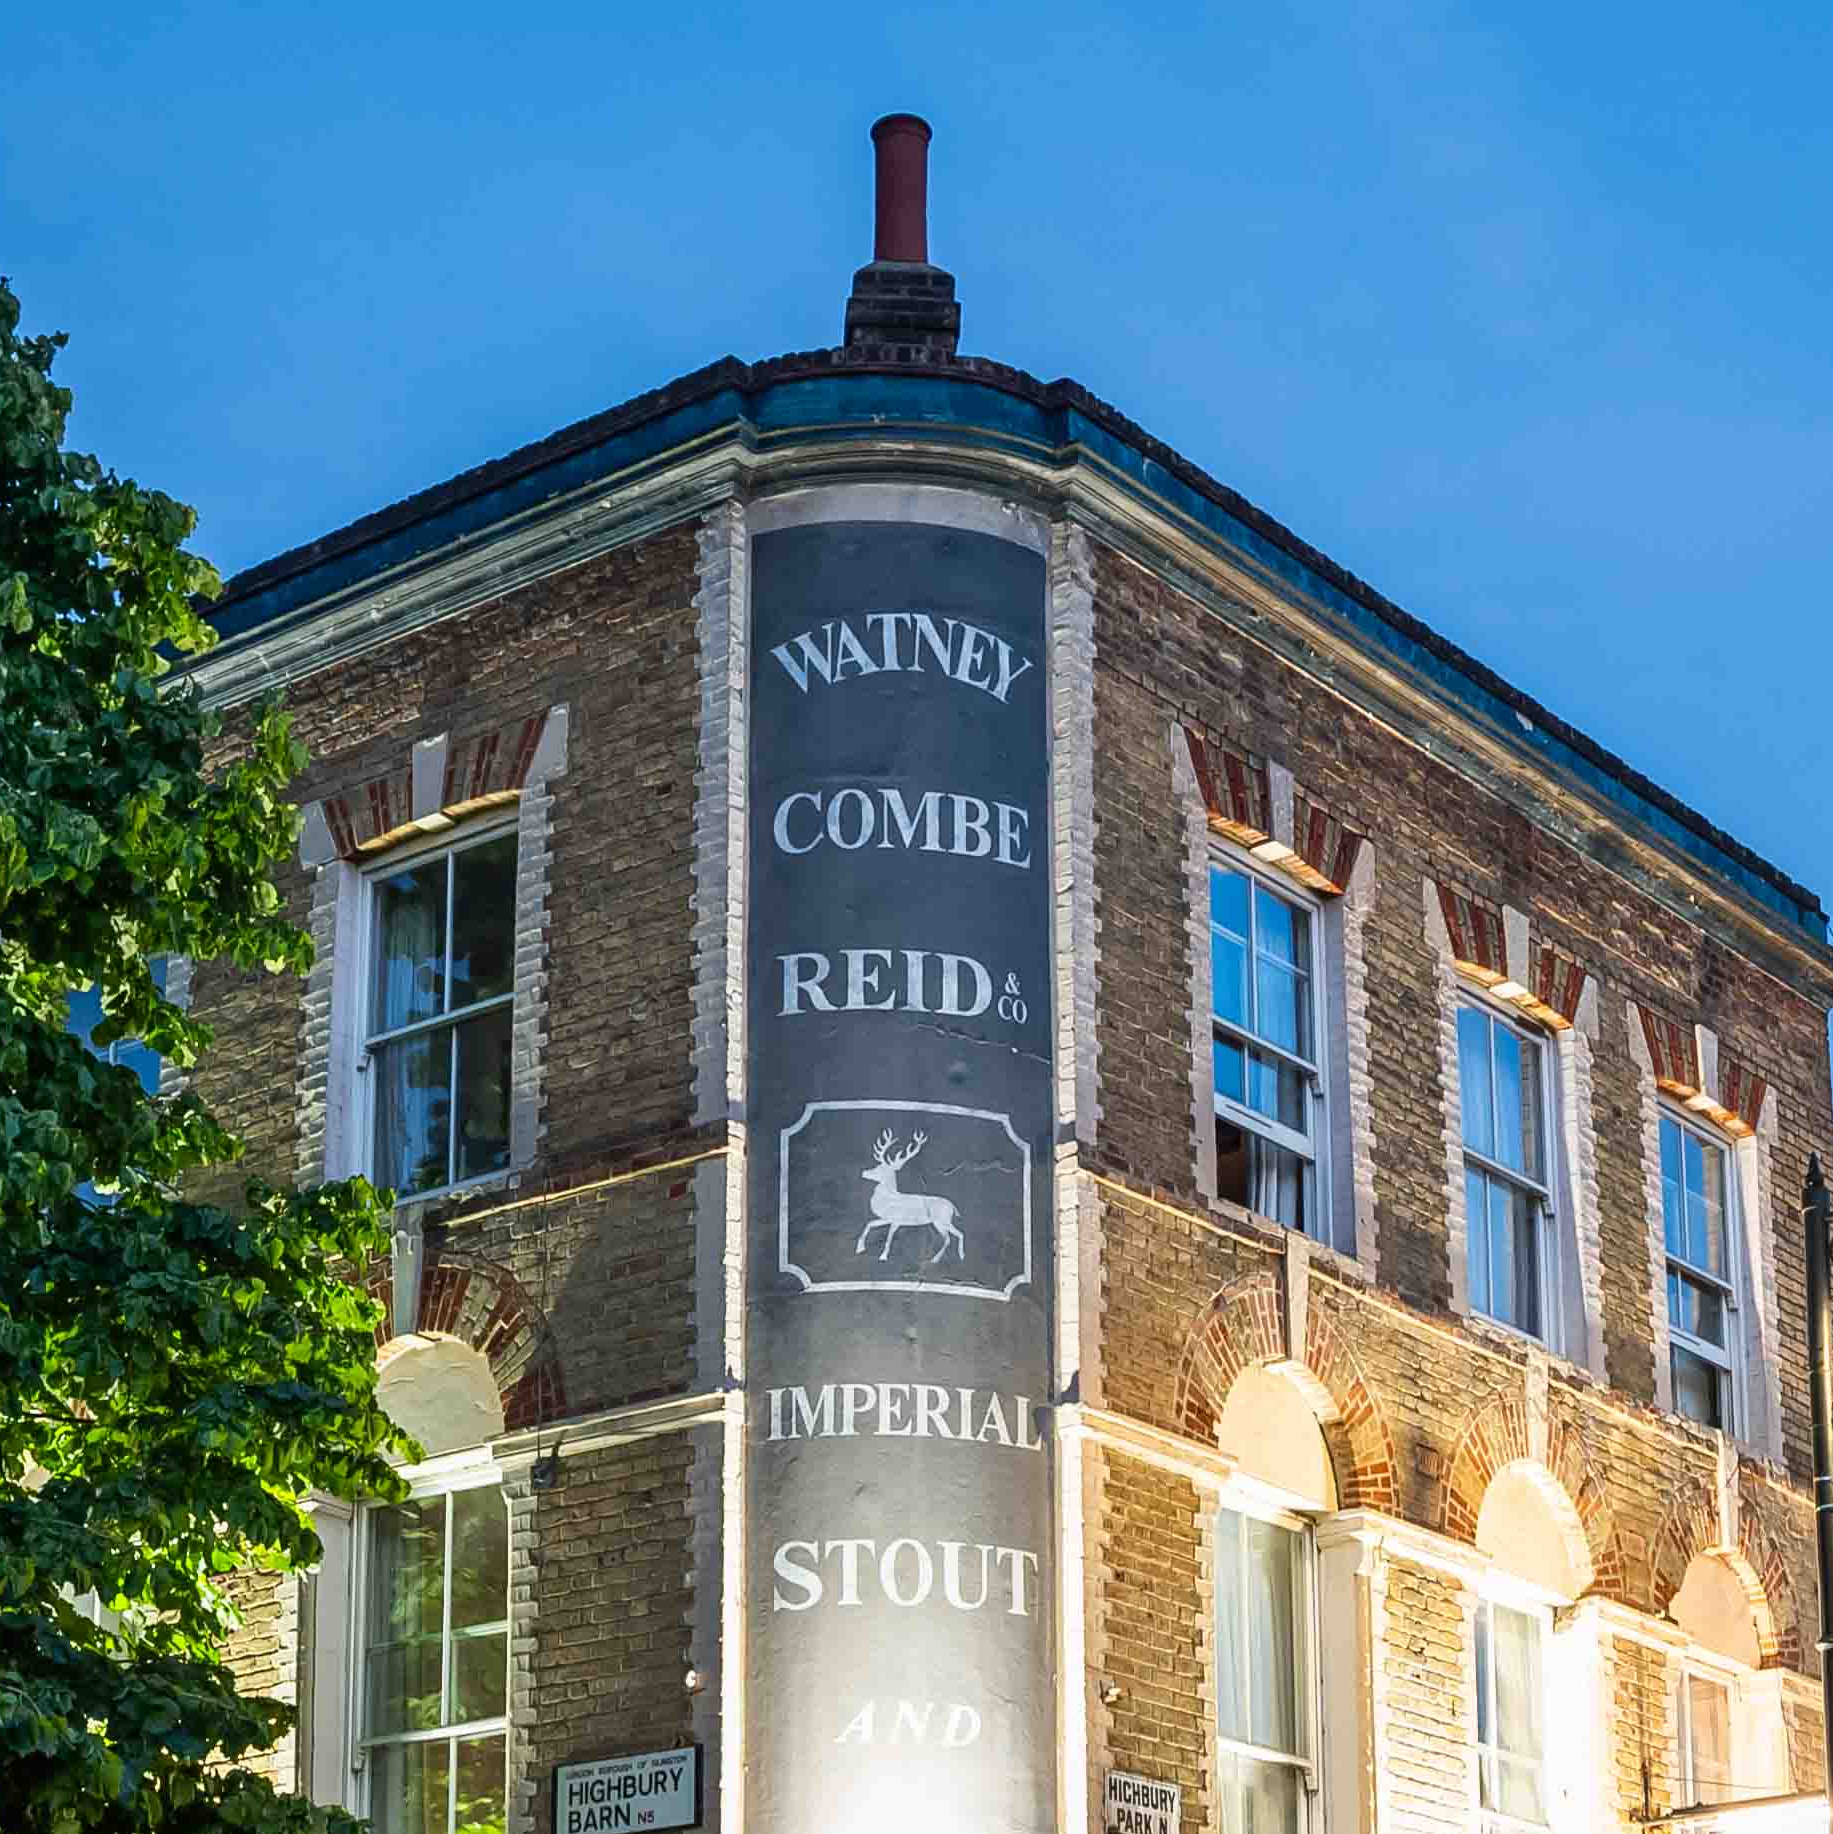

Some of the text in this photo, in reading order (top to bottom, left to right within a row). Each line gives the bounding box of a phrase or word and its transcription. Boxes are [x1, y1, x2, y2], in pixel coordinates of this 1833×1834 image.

[769, 612, 1034, 704] WATNEY
[773, 788, 1031, 869] COMBE
[774, 948, 1021, 1017] REID &
[765, 1382, 1043, 1451] IMPERIAL
[772, 1537, 1039, 1616] STOUT
[833, 1699, 981, 1748] AND
[567, 1802, 655, 1834] BARN N5
[568, 1766, 684, 1807] HIGHBURY
[1108, 1775, 1176, 1813] HIGHBURY
